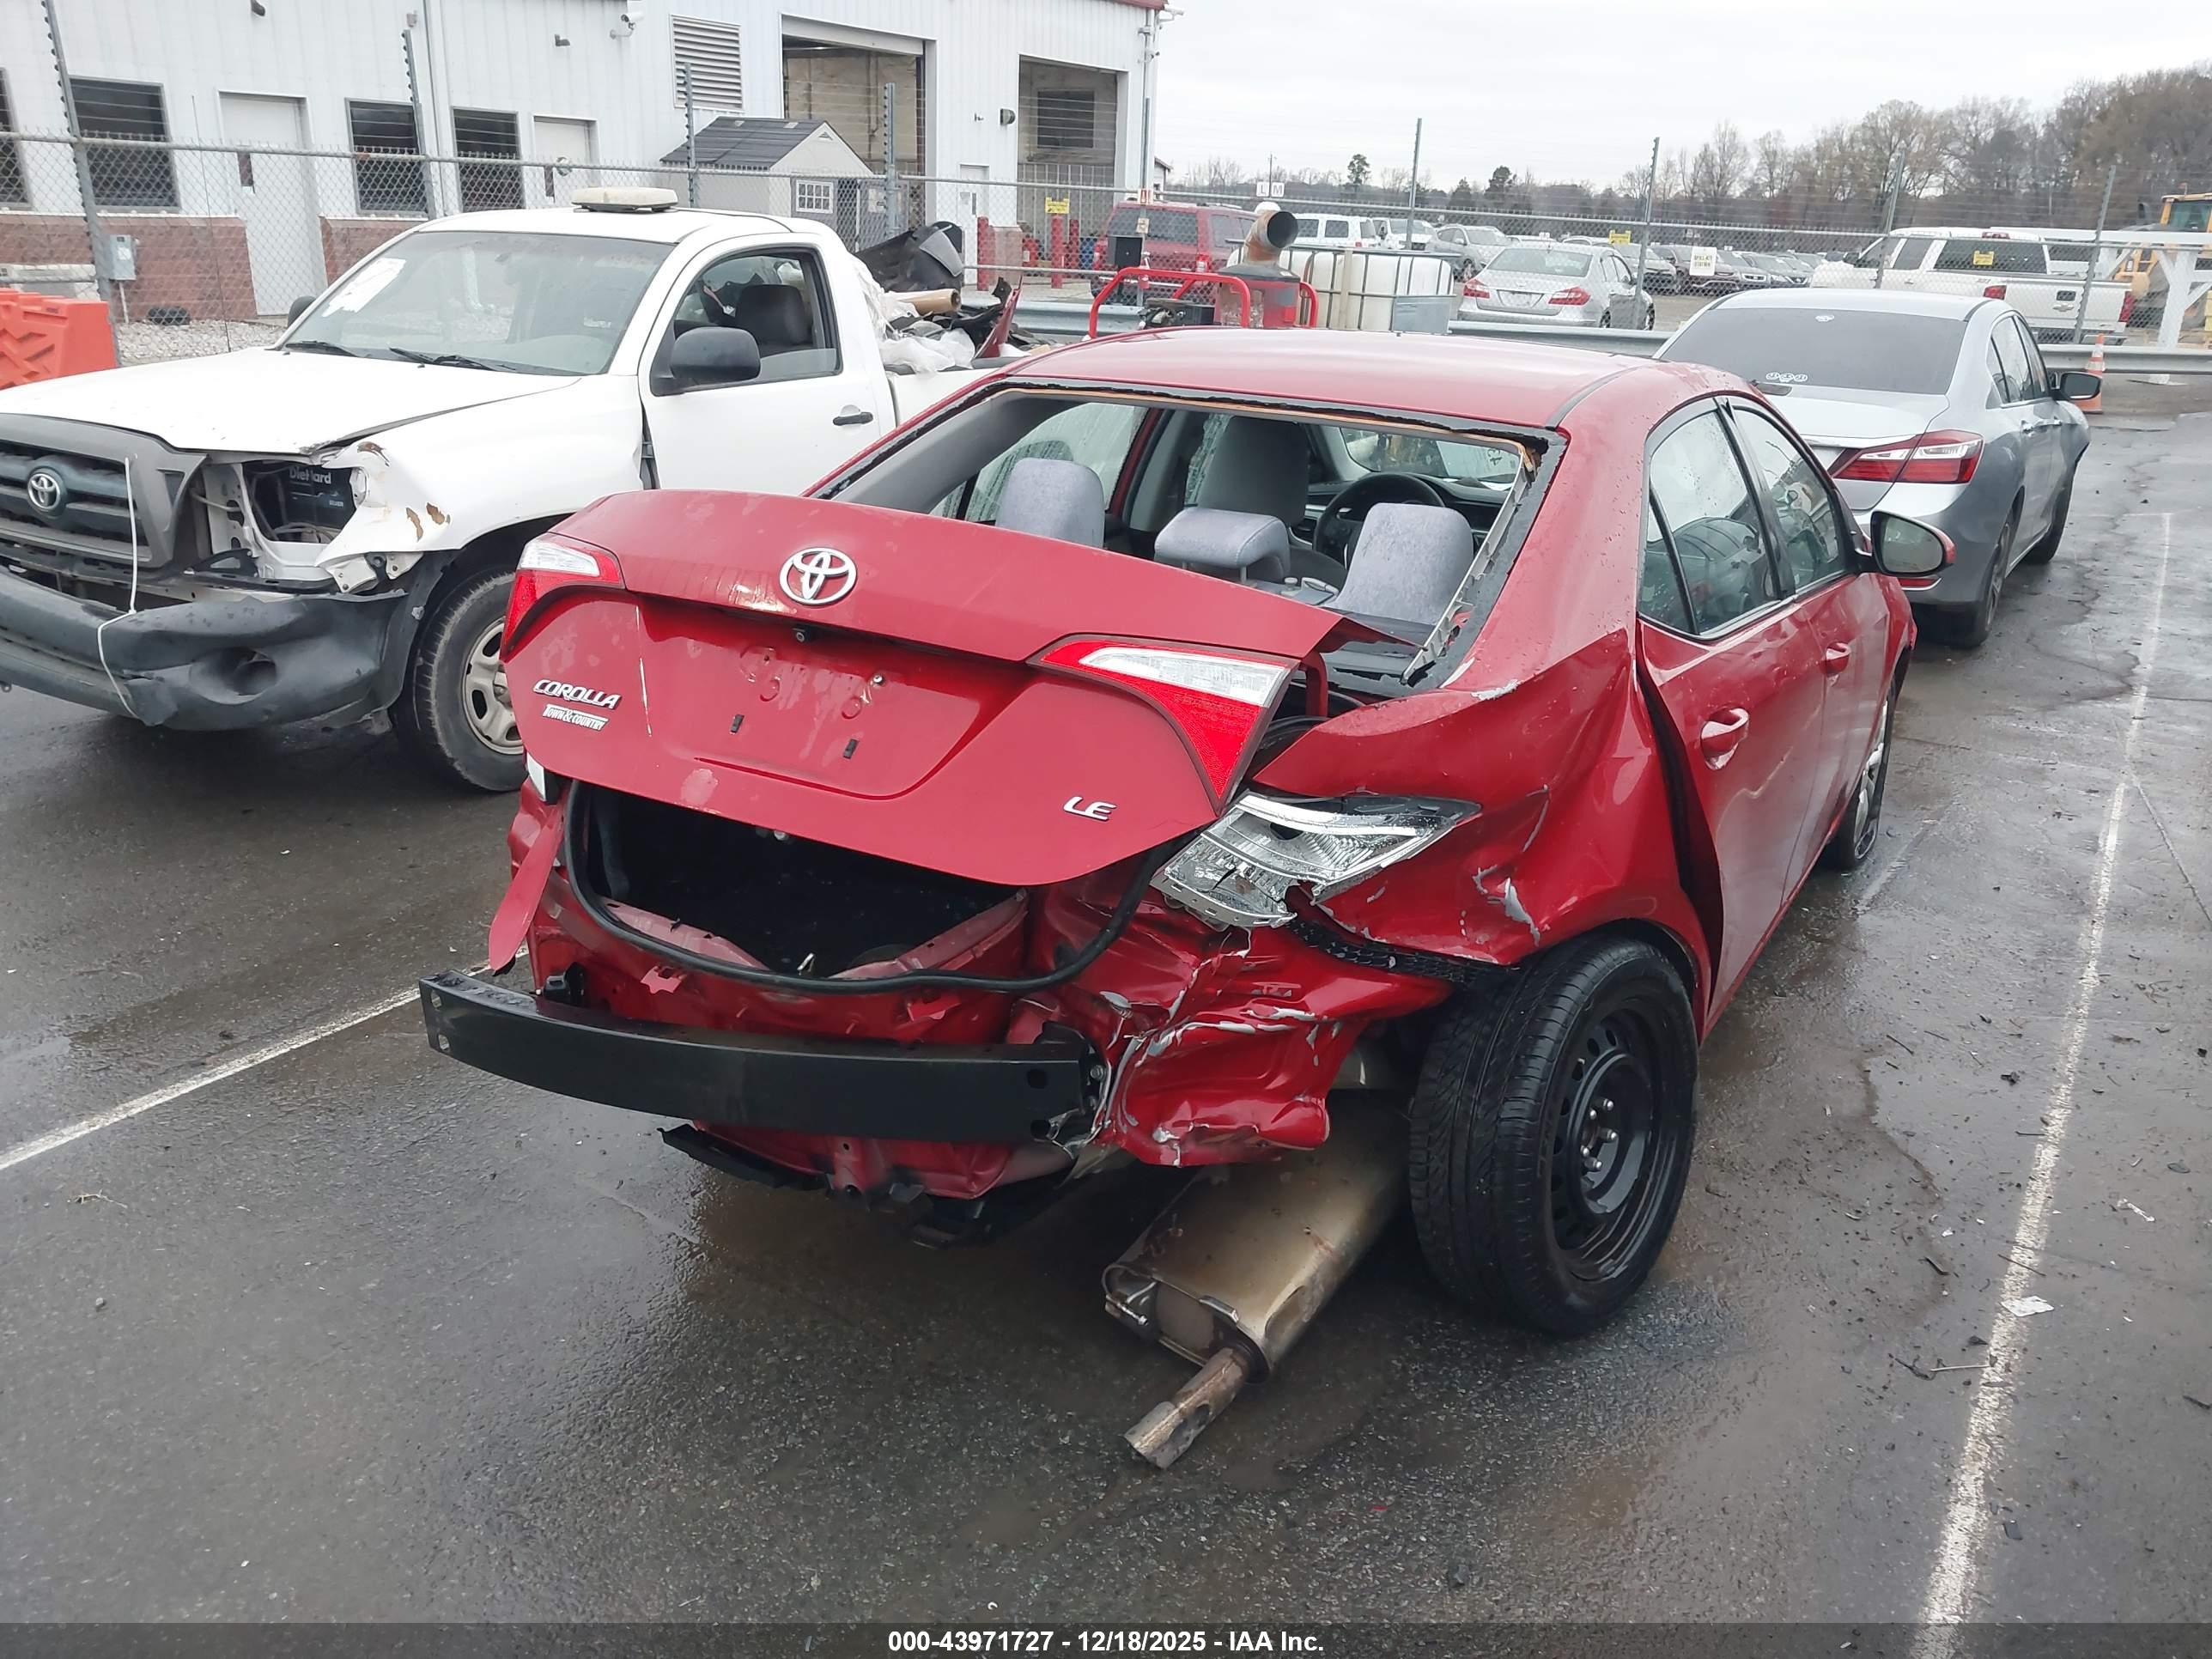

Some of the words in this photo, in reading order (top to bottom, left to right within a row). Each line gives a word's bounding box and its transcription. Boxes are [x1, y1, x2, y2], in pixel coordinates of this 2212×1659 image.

[1273, 185, 1283, 196] M
[532, 678, 622, 710] COROLLA
[1063, 796, 1117, 822] LE
